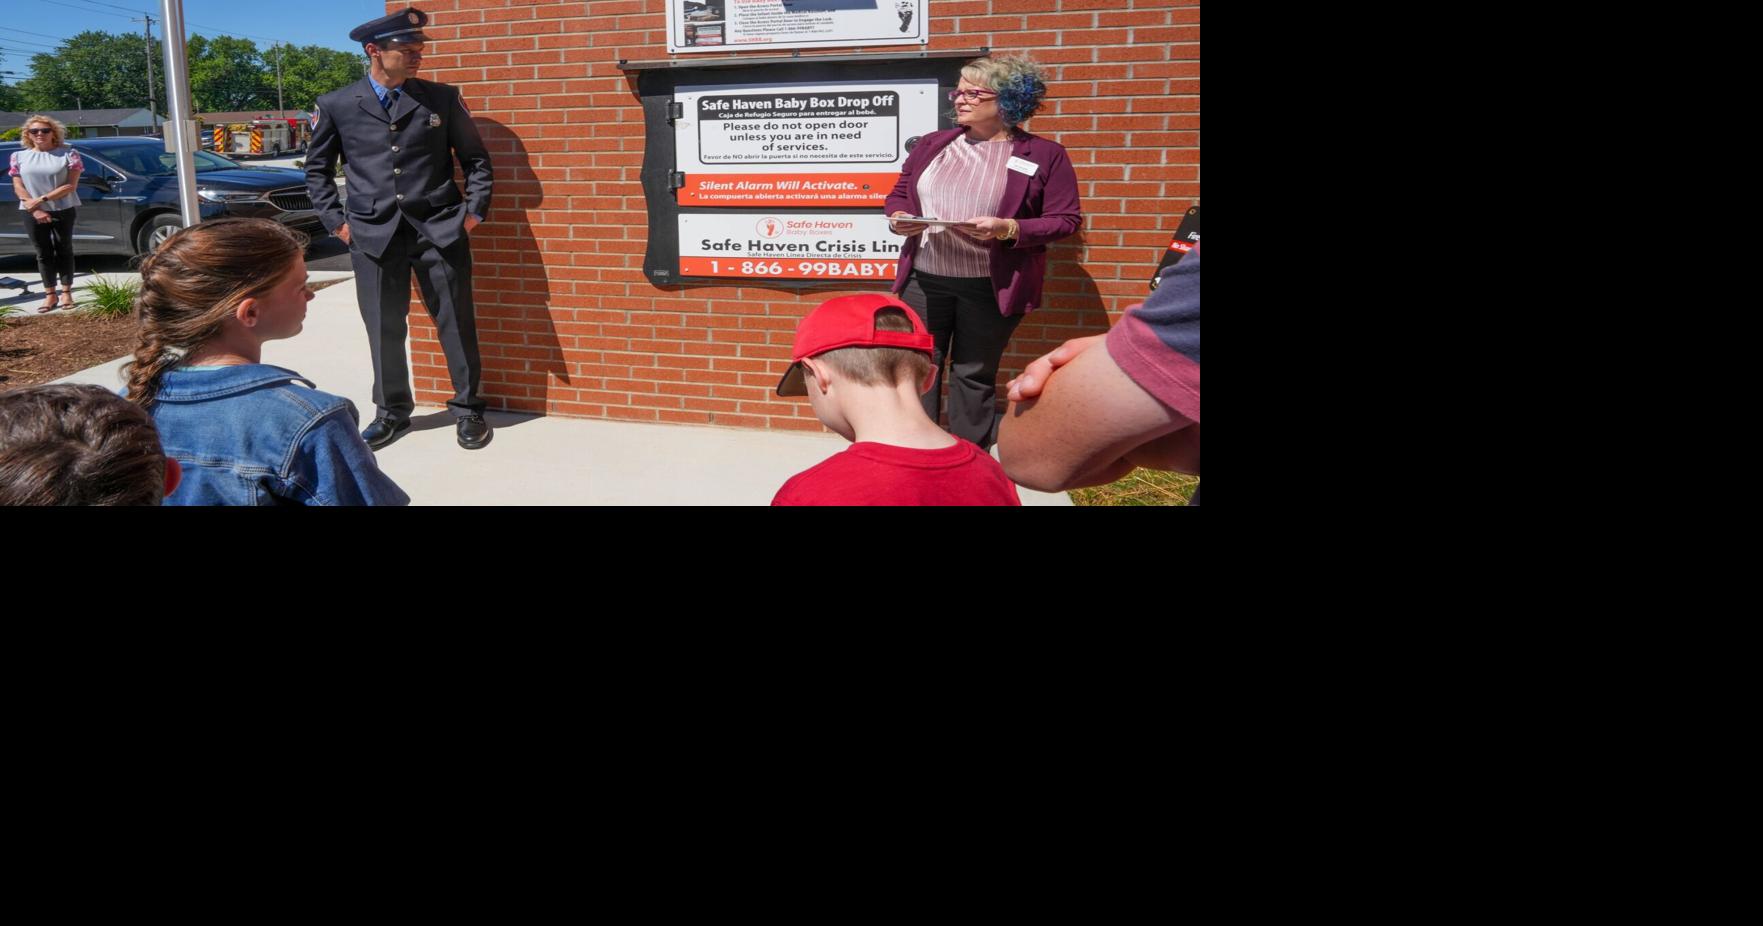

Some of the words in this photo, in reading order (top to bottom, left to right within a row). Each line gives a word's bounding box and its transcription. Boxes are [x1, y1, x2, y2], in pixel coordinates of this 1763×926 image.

[702, 100, 730, 110] Safe
[732, 99, 772, 110] Haven
[775, 98, 807, 110] Baby
[810, 97, 835, 108] Box
[838, 96, 870, 109] Drop
[872, 95, 894, 106] Off
[723, 122, 760, 130] Please
[805, 122, 836, 130] open
[839, 120, 868, 128] door
[730, 133, 767, 141] unless
[770, 134, 791, 142] you
[831, 131, 861, 139] need
[762, 143, 774, 151] of
[777, 143, 828, 151] services.
[699, 181, 734, 190] Silent
[736, 181, 773, 190] Alarm
[776, 181, 800, 190] Will
[802, 181, 858, 190] Activate.
[787, 220, 812, 228] Safe
[815, 221, 853, 229] Haven
[701, 239, 742, 251] Safe
[748, 240, 809, 252] Haven
[816, 240, 866, 252] Crisis
[872, 240, 899, 252] Lin
[711, 261, 718, 273] 1
[741, 261, 782, 275] 866
